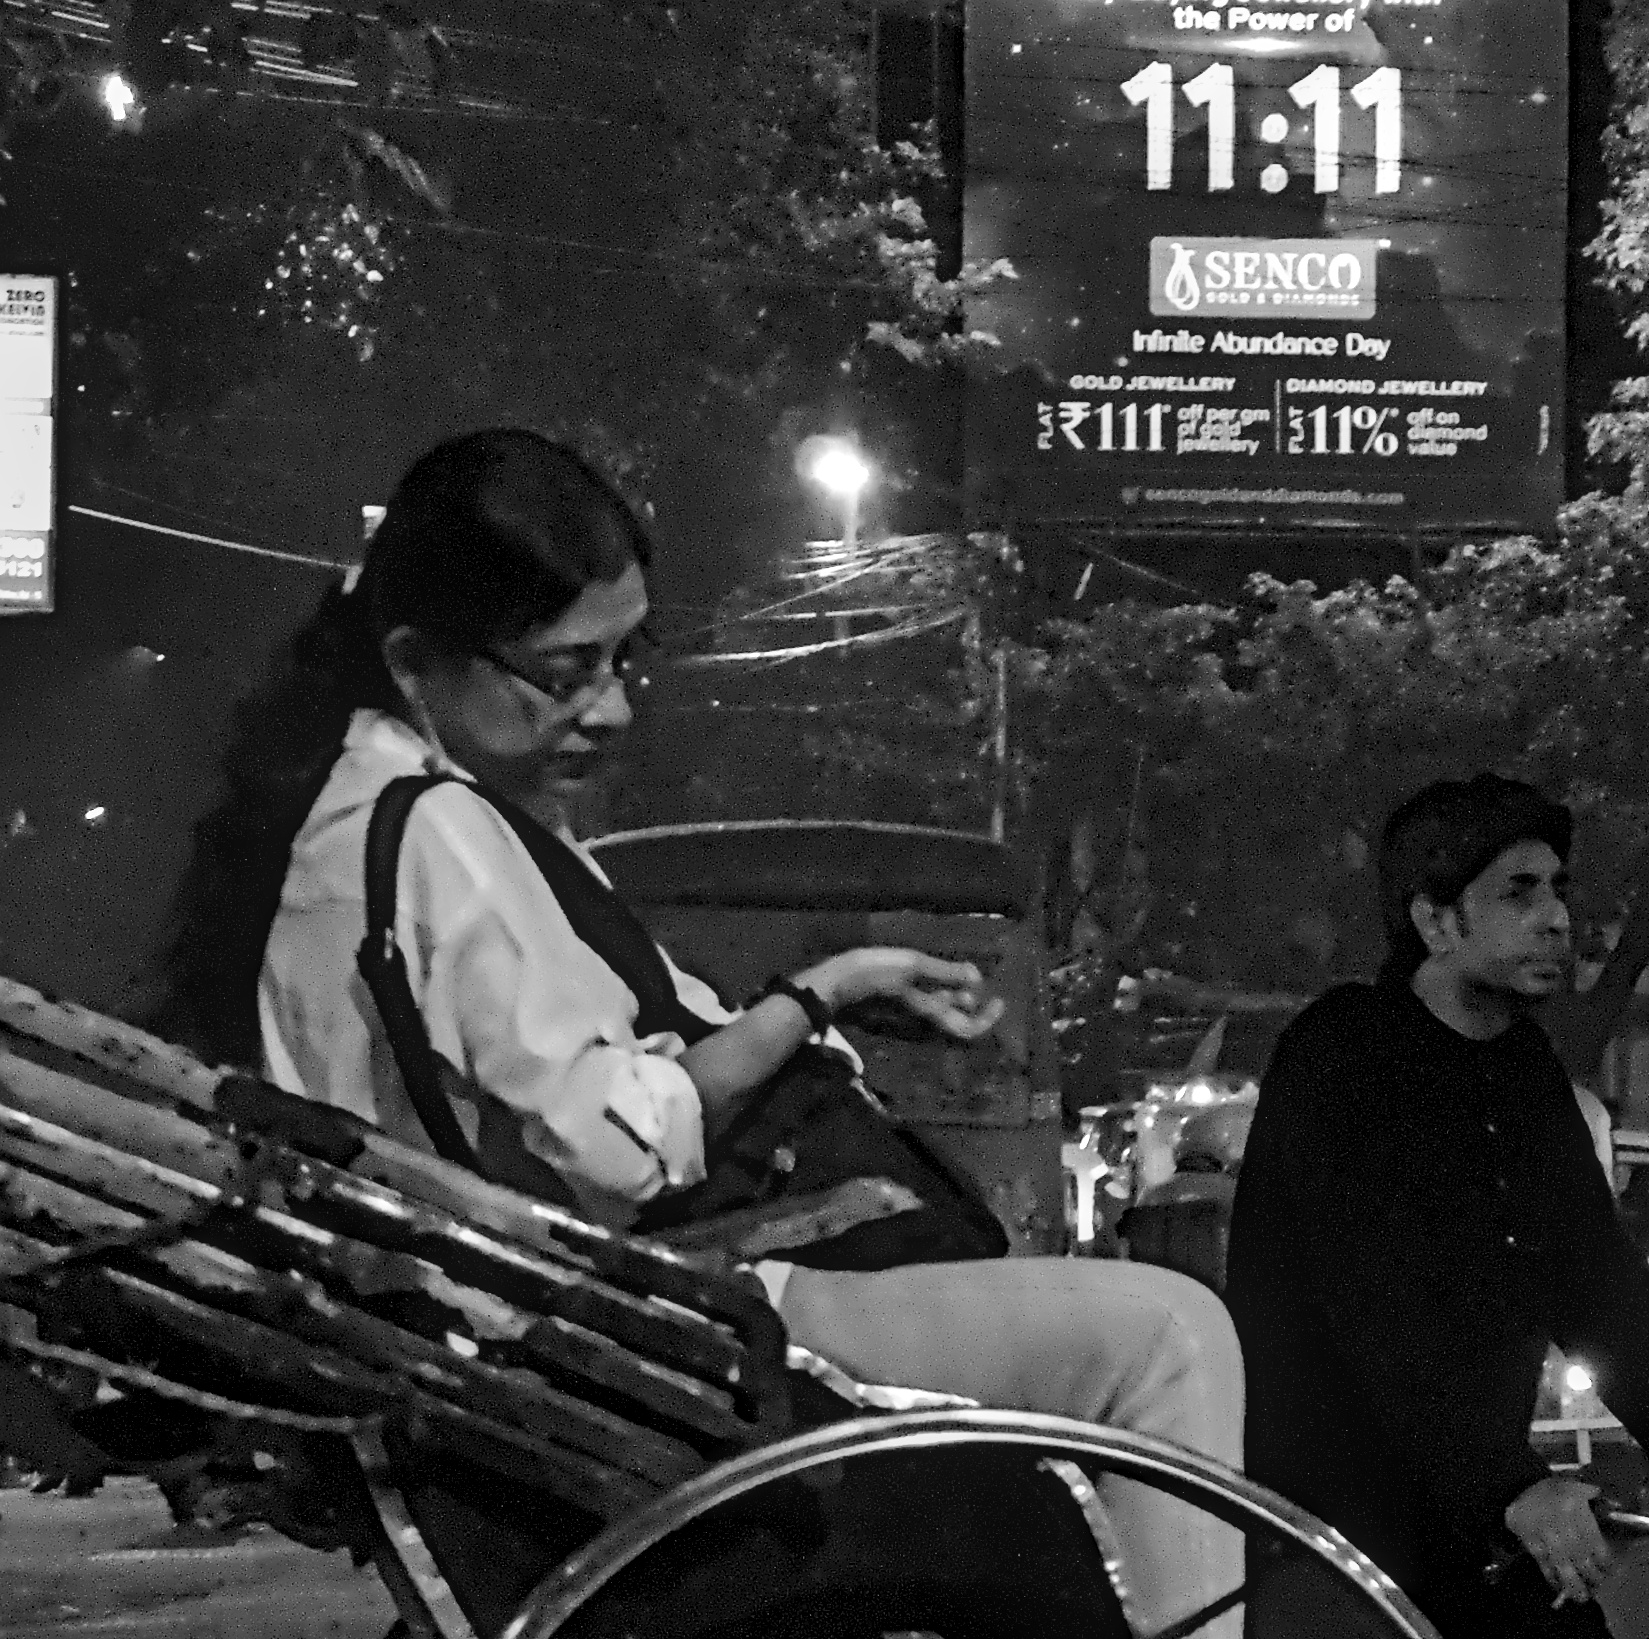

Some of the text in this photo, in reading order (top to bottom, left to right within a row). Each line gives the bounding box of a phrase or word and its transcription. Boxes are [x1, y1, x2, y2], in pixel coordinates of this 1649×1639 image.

[1173, 6, 1355, 32] the Power of
[1120, 61, 1402, 193] 11:11
[1204, 251, 1361, 290] SENCO
[1132, 329, 1391, 361] Infinite Abundance Day
[1069, 374, 1236, 392] GOLD JEWELLERY
[1286, 378, 1488, 396] DIAMOND JEWELLERY
[1177, 403, 1205, 421] off
[1240, 408, 1271, 427] gm
[1406, 407, 1460, 425] off on
[1406, 424, 1488, 441] diamond
